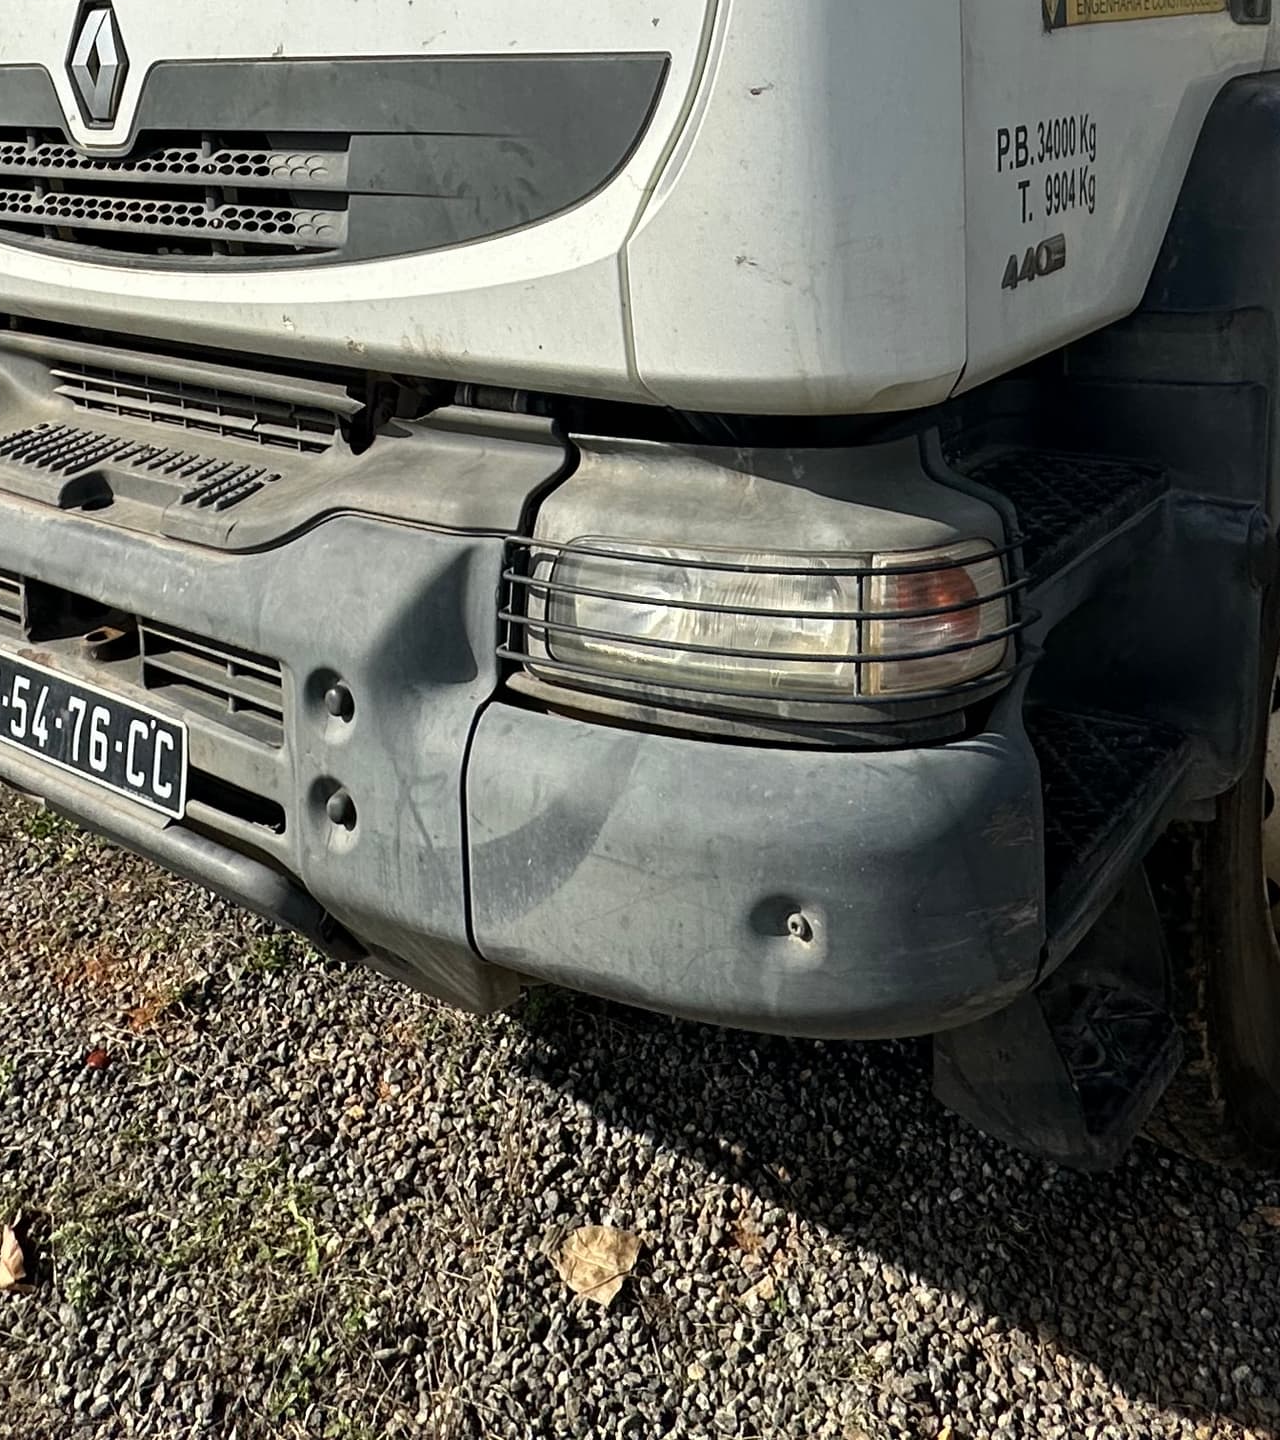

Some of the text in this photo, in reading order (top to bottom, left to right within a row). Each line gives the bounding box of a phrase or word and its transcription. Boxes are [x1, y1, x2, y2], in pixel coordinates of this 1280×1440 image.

[997, 114, 1096, 173] P.B. 34000 Kg
[1018, 165, 1096, 223] T. 9904 Kg
[1001, 233, 1066, 290] 440
